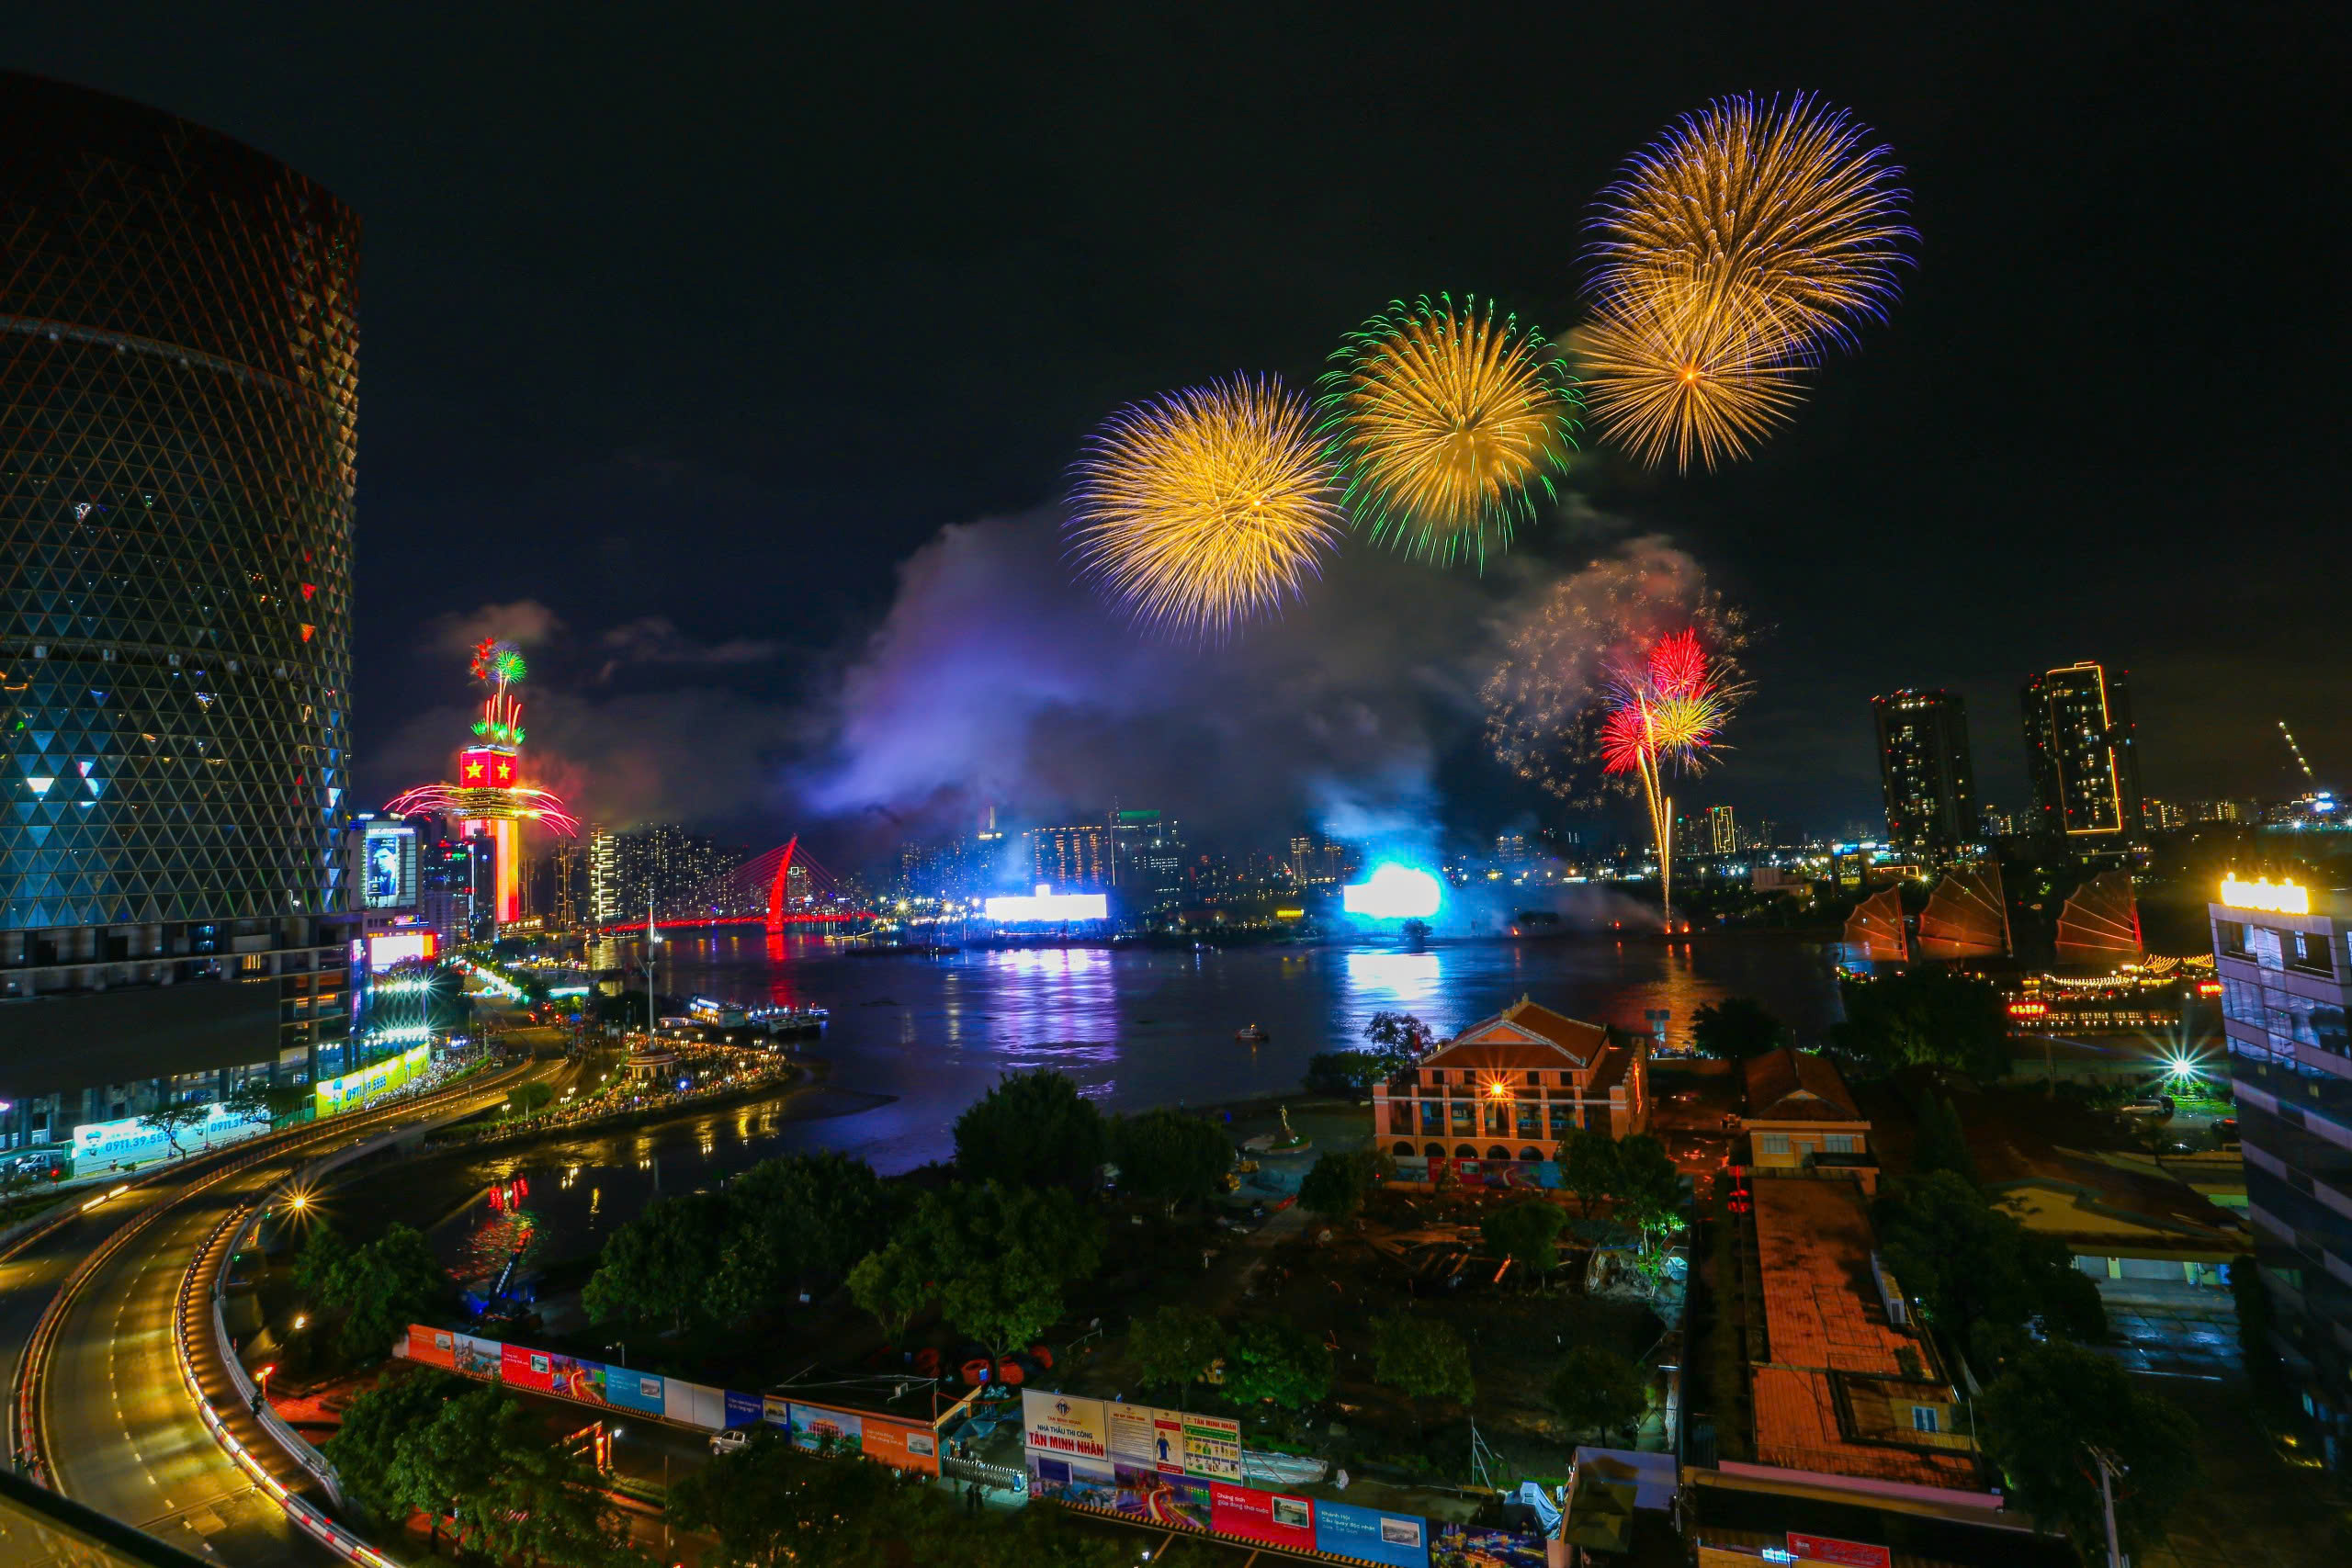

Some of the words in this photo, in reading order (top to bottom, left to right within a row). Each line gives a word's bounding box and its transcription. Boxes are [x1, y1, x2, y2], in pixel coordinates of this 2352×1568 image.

[1050, 1426, 1066, 1435] THẦU
[1076, 1430, 1092, 1438] CÔNG
[1029, 1431, 1047, 1447] TÂN
[1049, 1436, 1074, 1451] MINH
[1077, 1440, 1104, 1456] NHÂN
